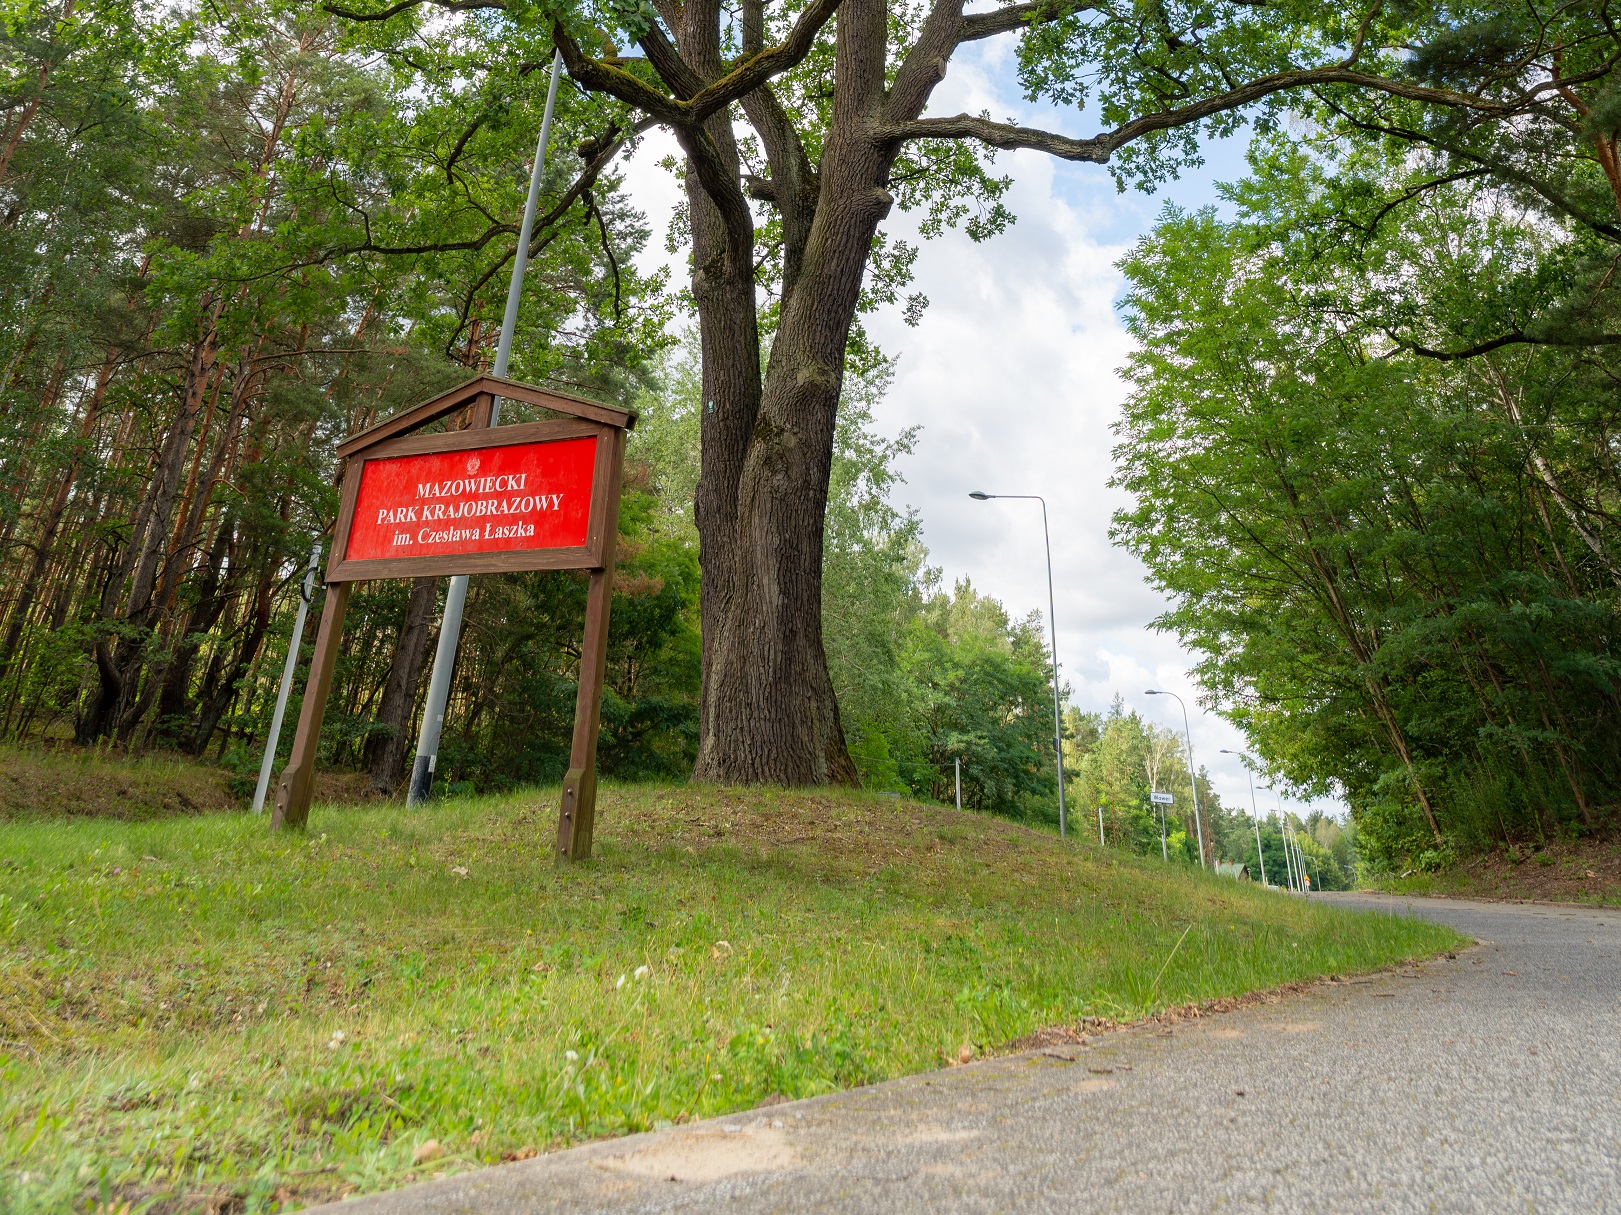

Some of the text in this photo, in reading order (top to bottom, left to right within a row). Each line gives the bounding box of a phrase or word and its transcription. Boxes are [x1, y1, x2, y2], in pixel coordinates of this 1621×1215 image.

[416, 474, 526, 498] MAZOWIECKI
[376, 494, 563, 525] PARK KRAJOBRAZOWY
[392, 521, 535, 546] im. Czesława Łaszka
